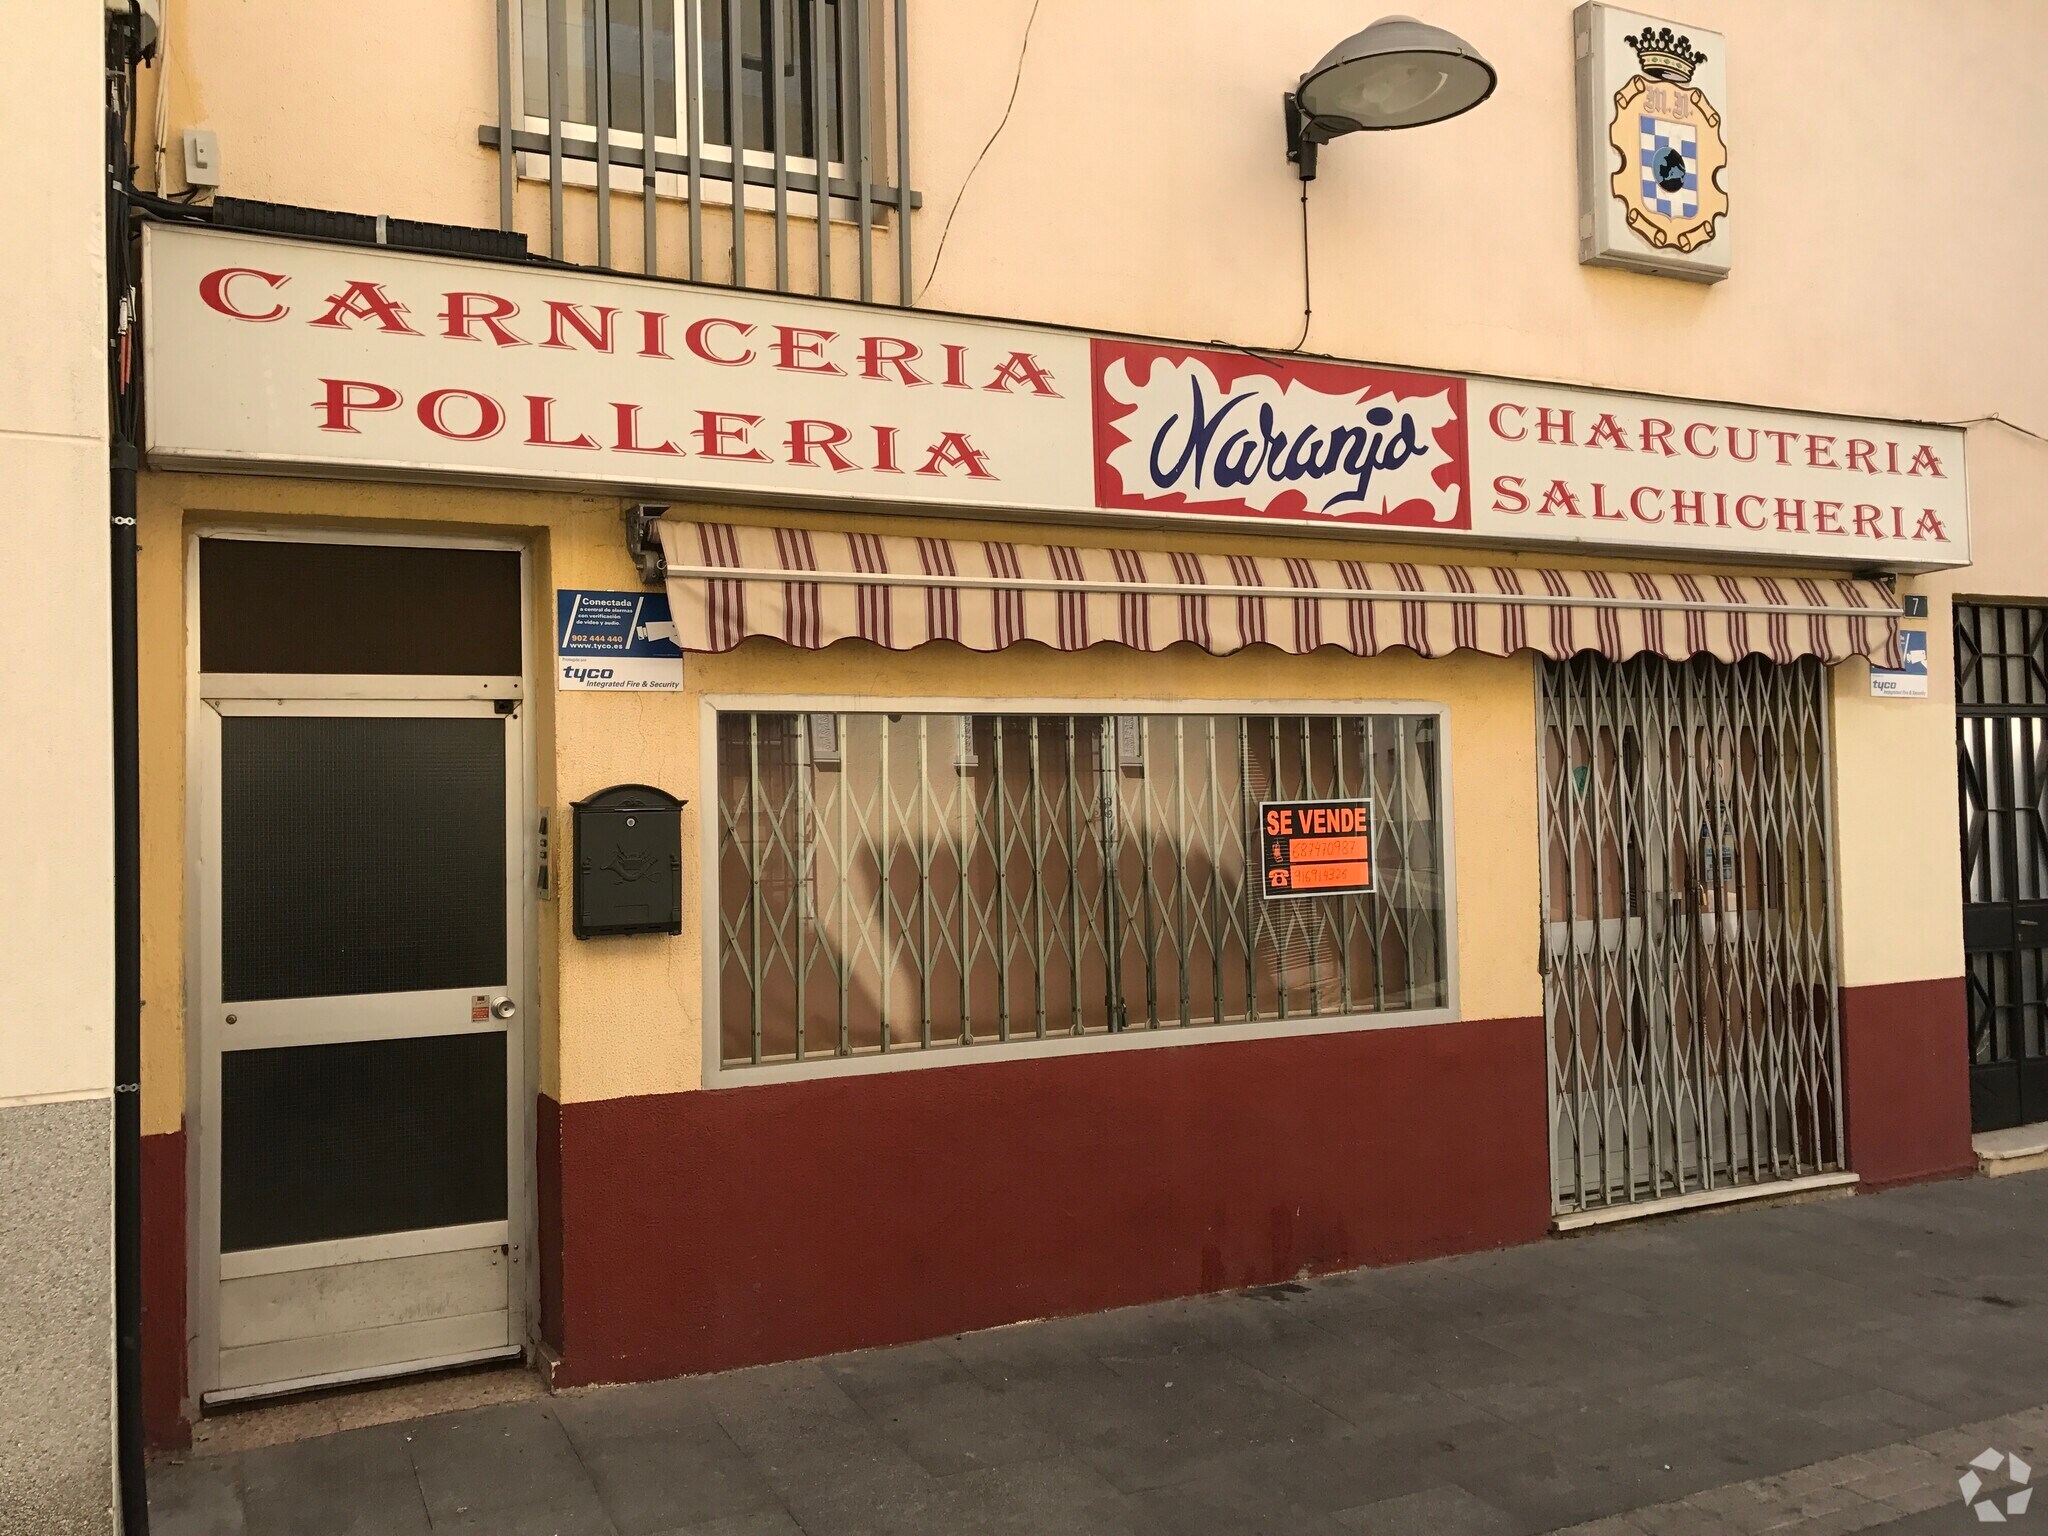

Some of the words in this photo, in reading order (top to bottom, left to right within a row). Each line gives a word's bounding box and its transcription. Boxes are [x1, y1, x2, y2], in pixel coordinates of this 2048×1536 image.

[199, 267, 1066, 399] CARNICERIA
[310, 378, 1001, 481] POLLERIA
[1488, 402, 1948, 479] CHARCUTERIA
[1150, 374, 1429, 513] Naranjo
[1491, 475, 1952, 543] SALCHICHERIA
[582, 597, 632, 607] Conectada
[1912, 597, 1919, 615] 7
[571, 634, 588, 642] 902
[563, 666, 614, 683] tyco
[586, 680, 625, 688] Integrated
[649, 681, 680, 689] Security
[1873, 680, 1897, 691] tyco
[1266, 810, 1293, 836] SE
[1298, 808, 1367, 834] VENDE
